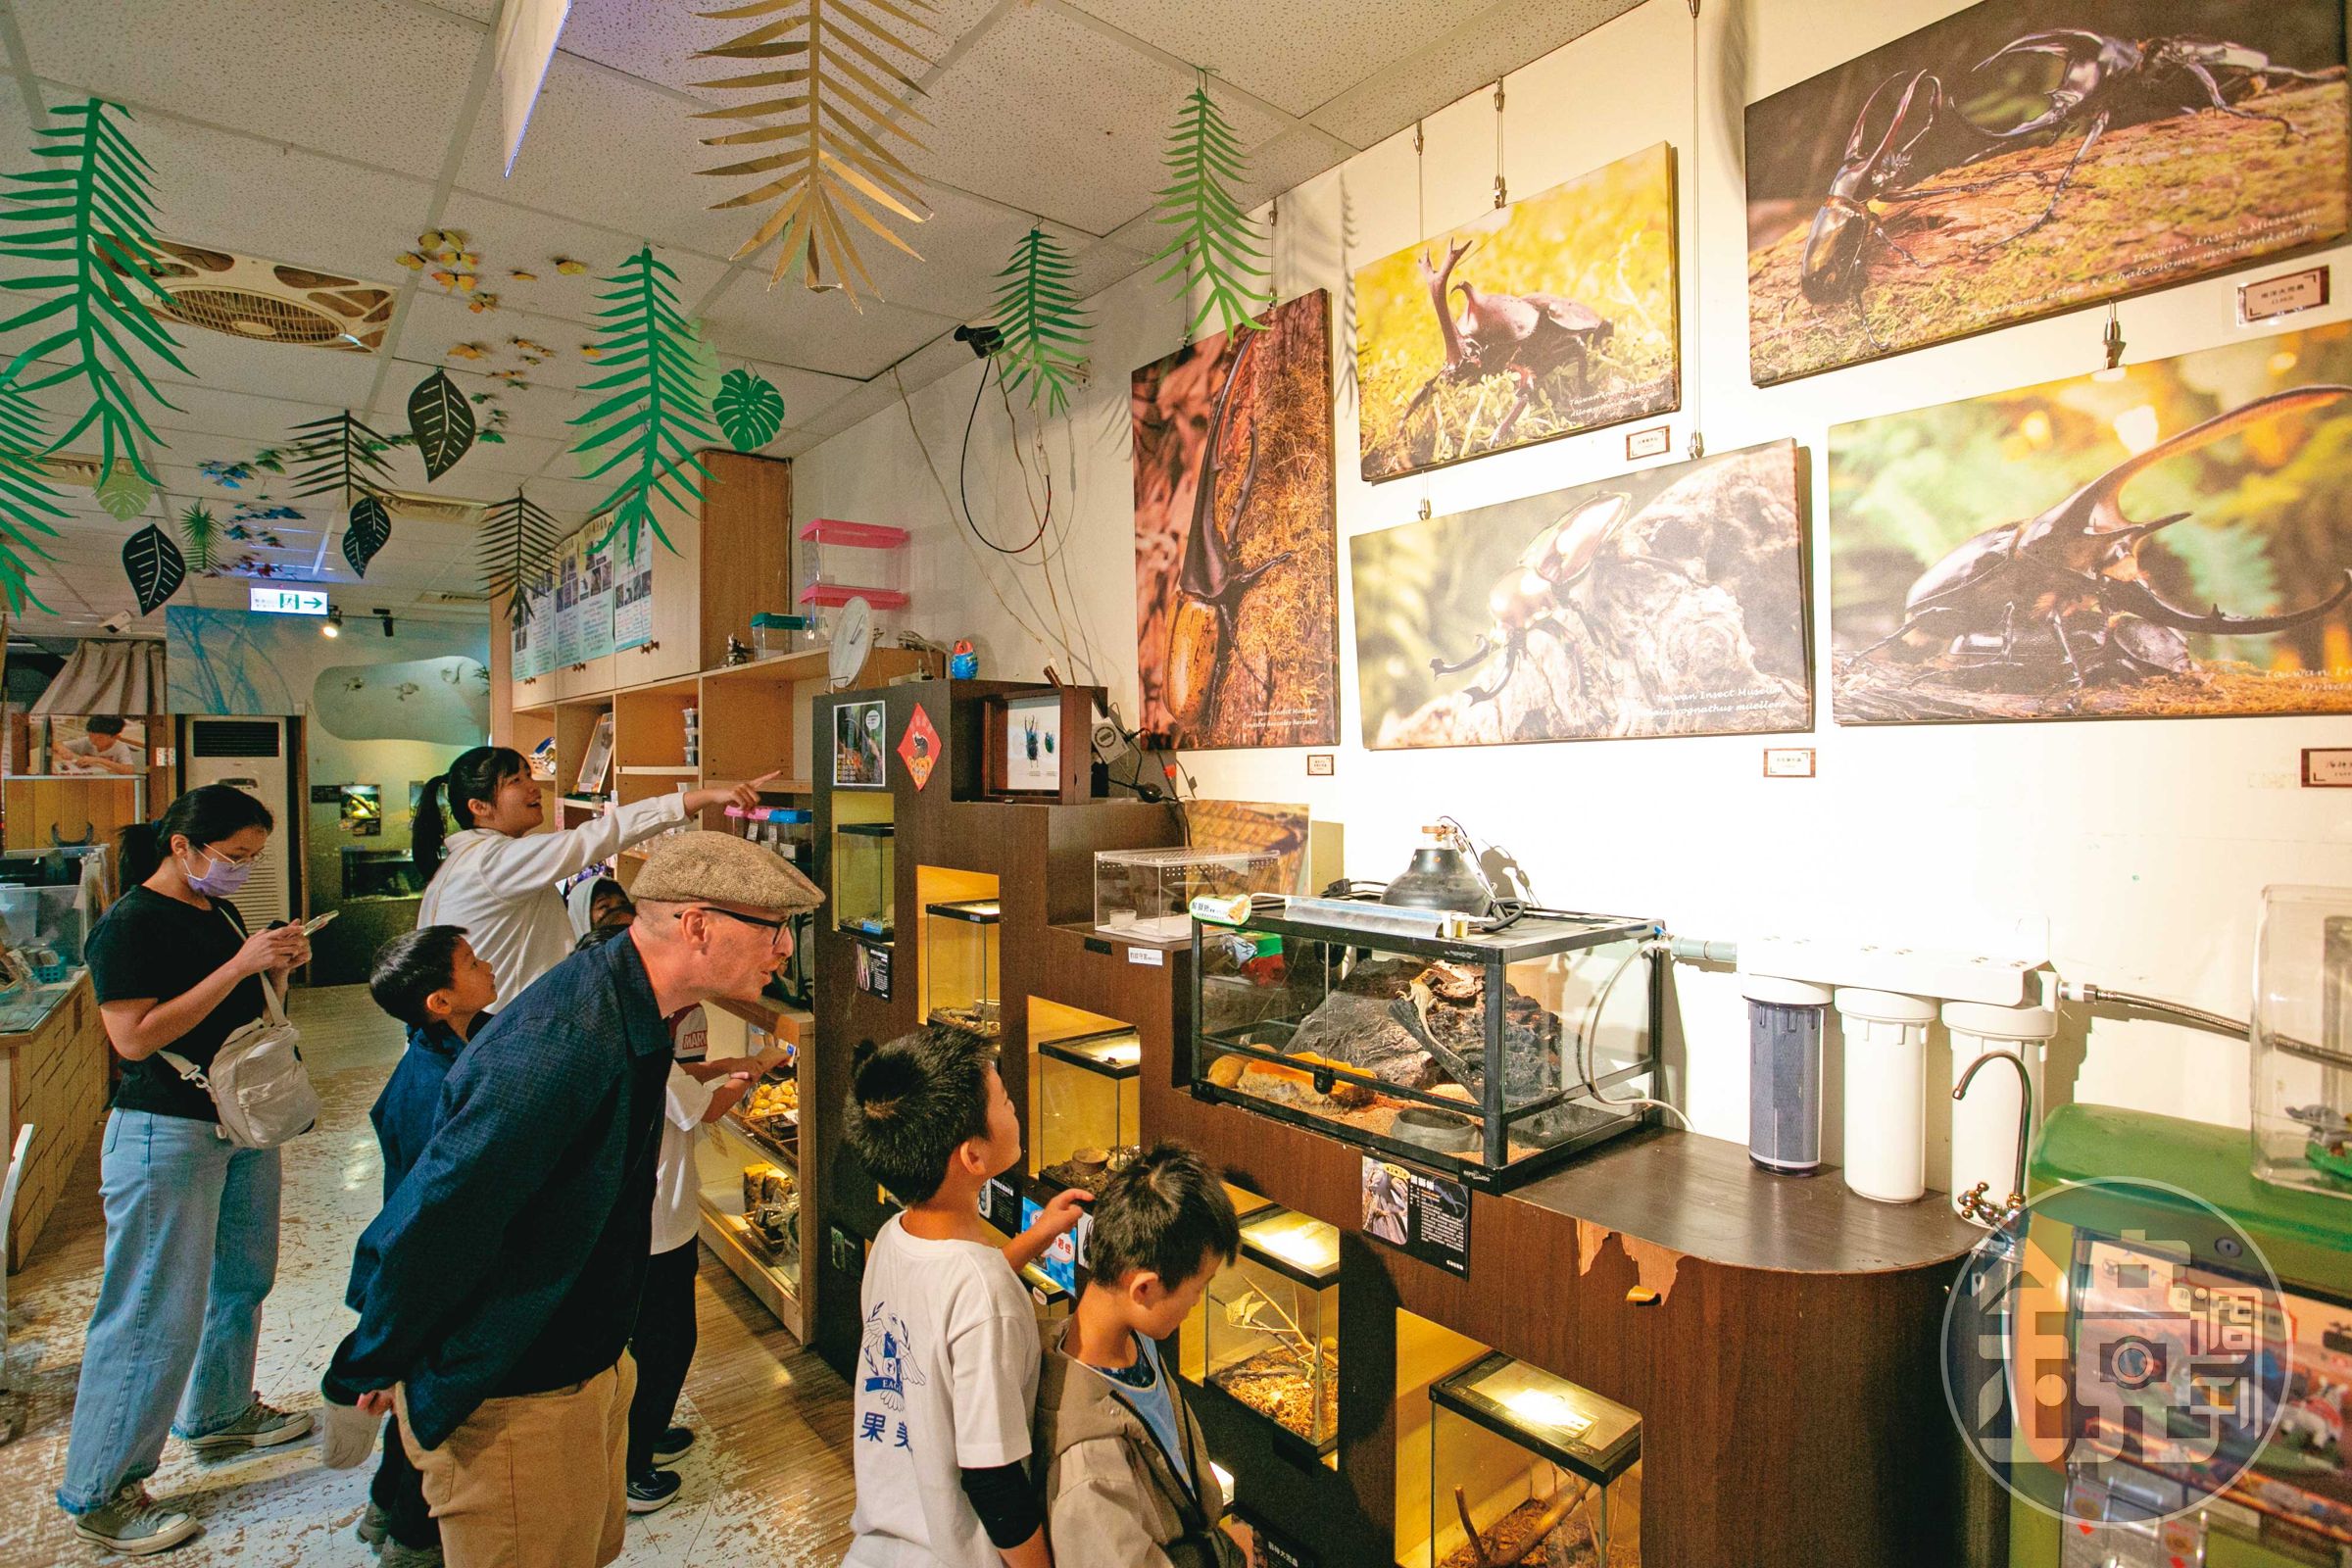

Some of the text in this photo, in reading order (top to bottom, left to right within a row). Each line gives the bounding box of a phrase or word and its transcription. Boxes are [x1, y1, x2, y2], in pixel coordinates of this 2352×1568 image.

[2132, 208, 2317, 264] Taiwan Insect Museum
[1700, 690, 1736, 700] Insect
[1738, 686, 1785, 697] Museum
